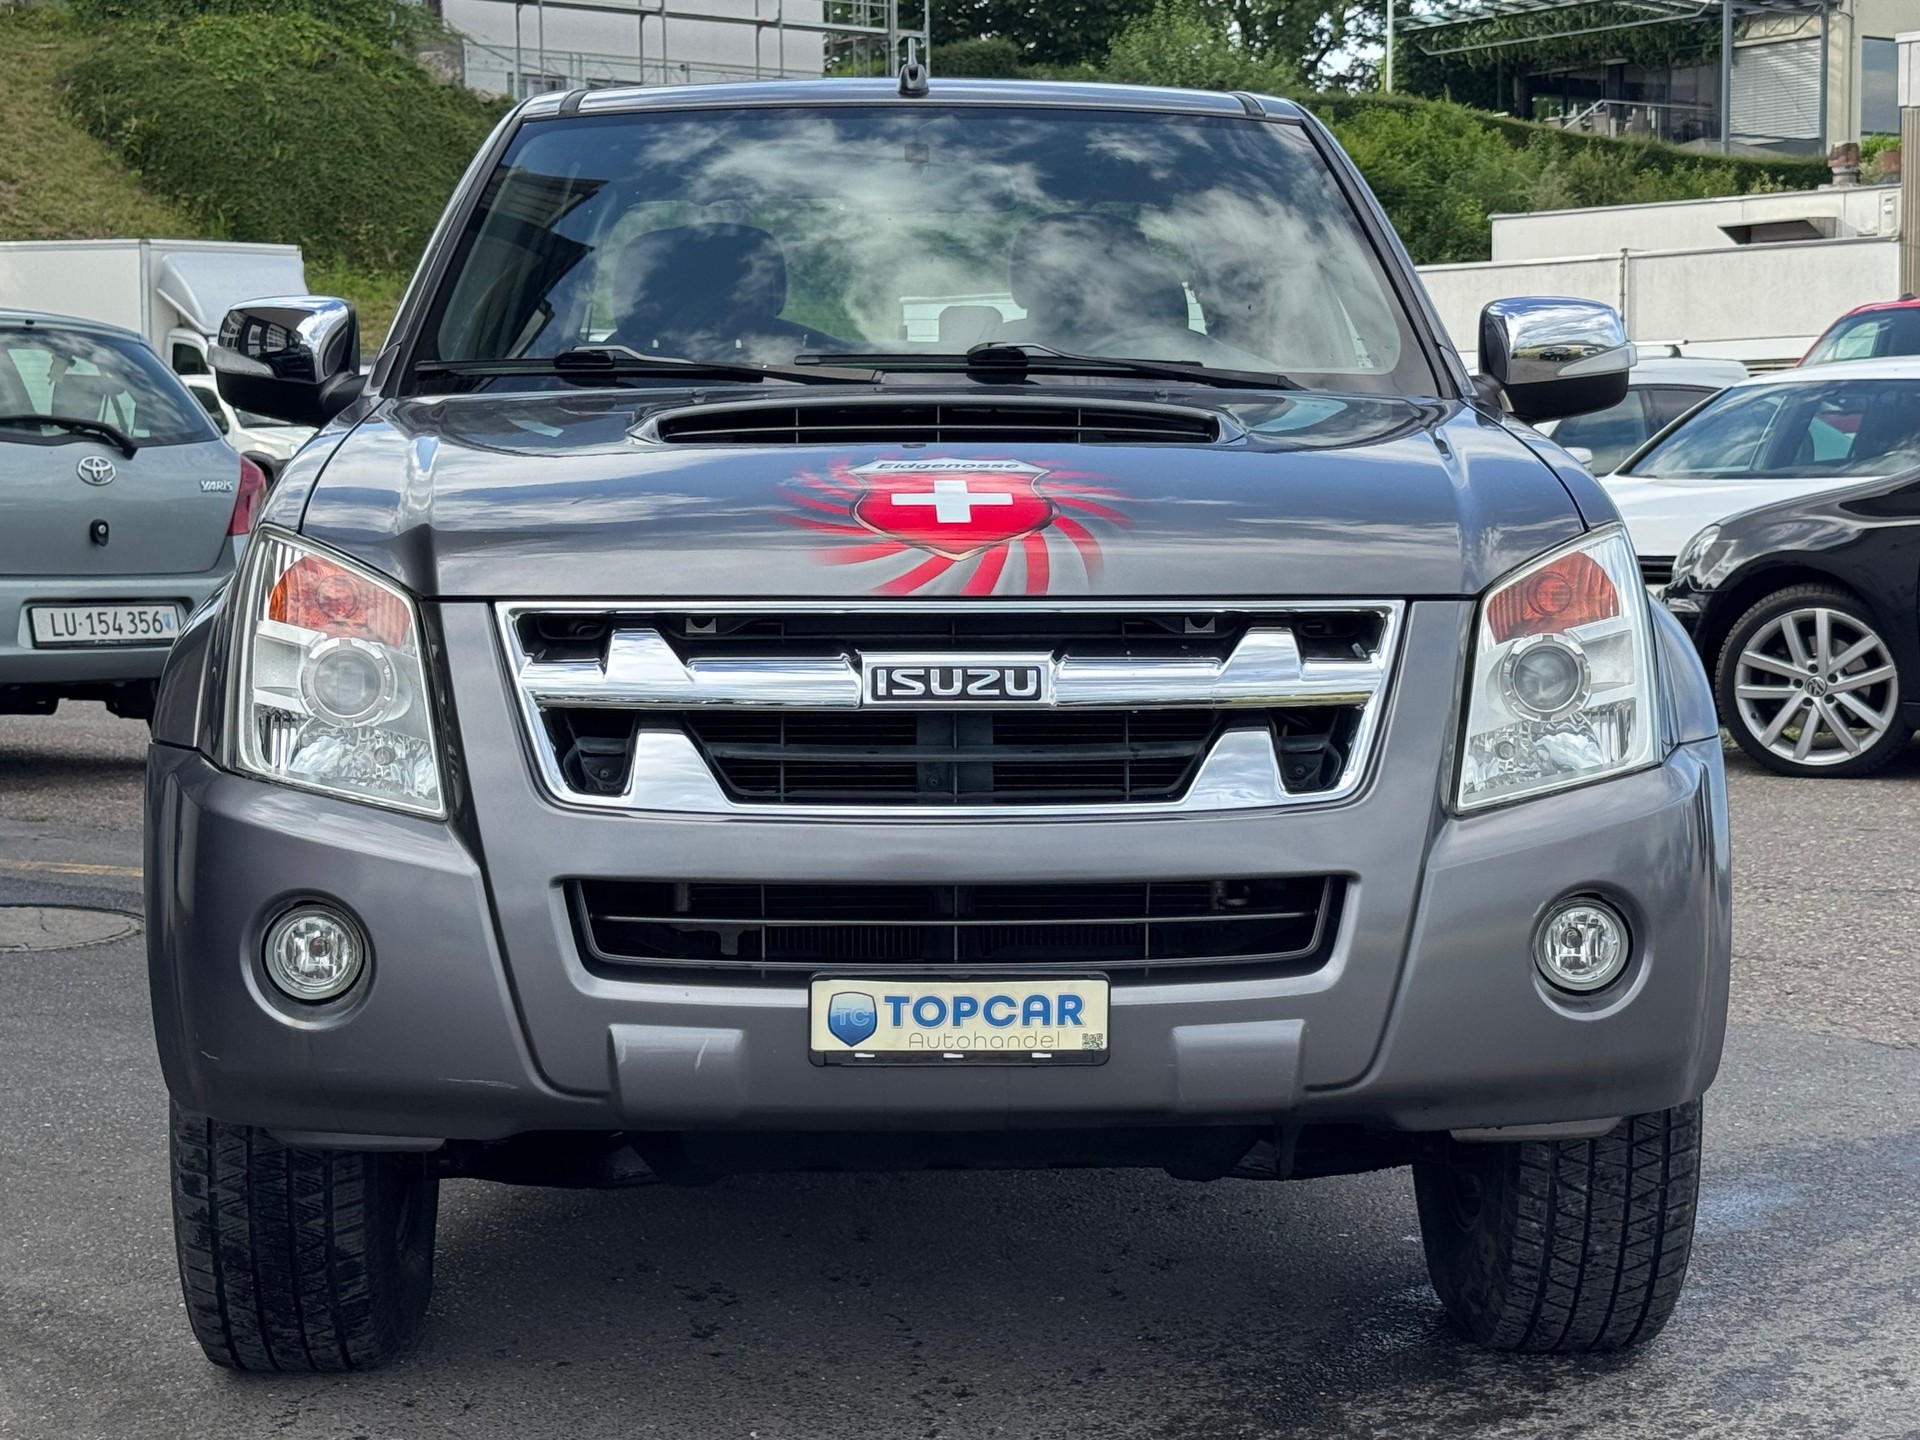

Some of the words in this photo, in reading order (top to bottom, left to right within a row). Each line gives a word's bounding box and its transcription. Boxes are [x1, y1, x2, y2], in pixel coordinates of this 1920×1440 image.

[876, 669, 1038, 696] ISUZU
[883, 993, 1085, 1028] TOPCAR
[908, 1031, 1061, 1049] Autohandel
